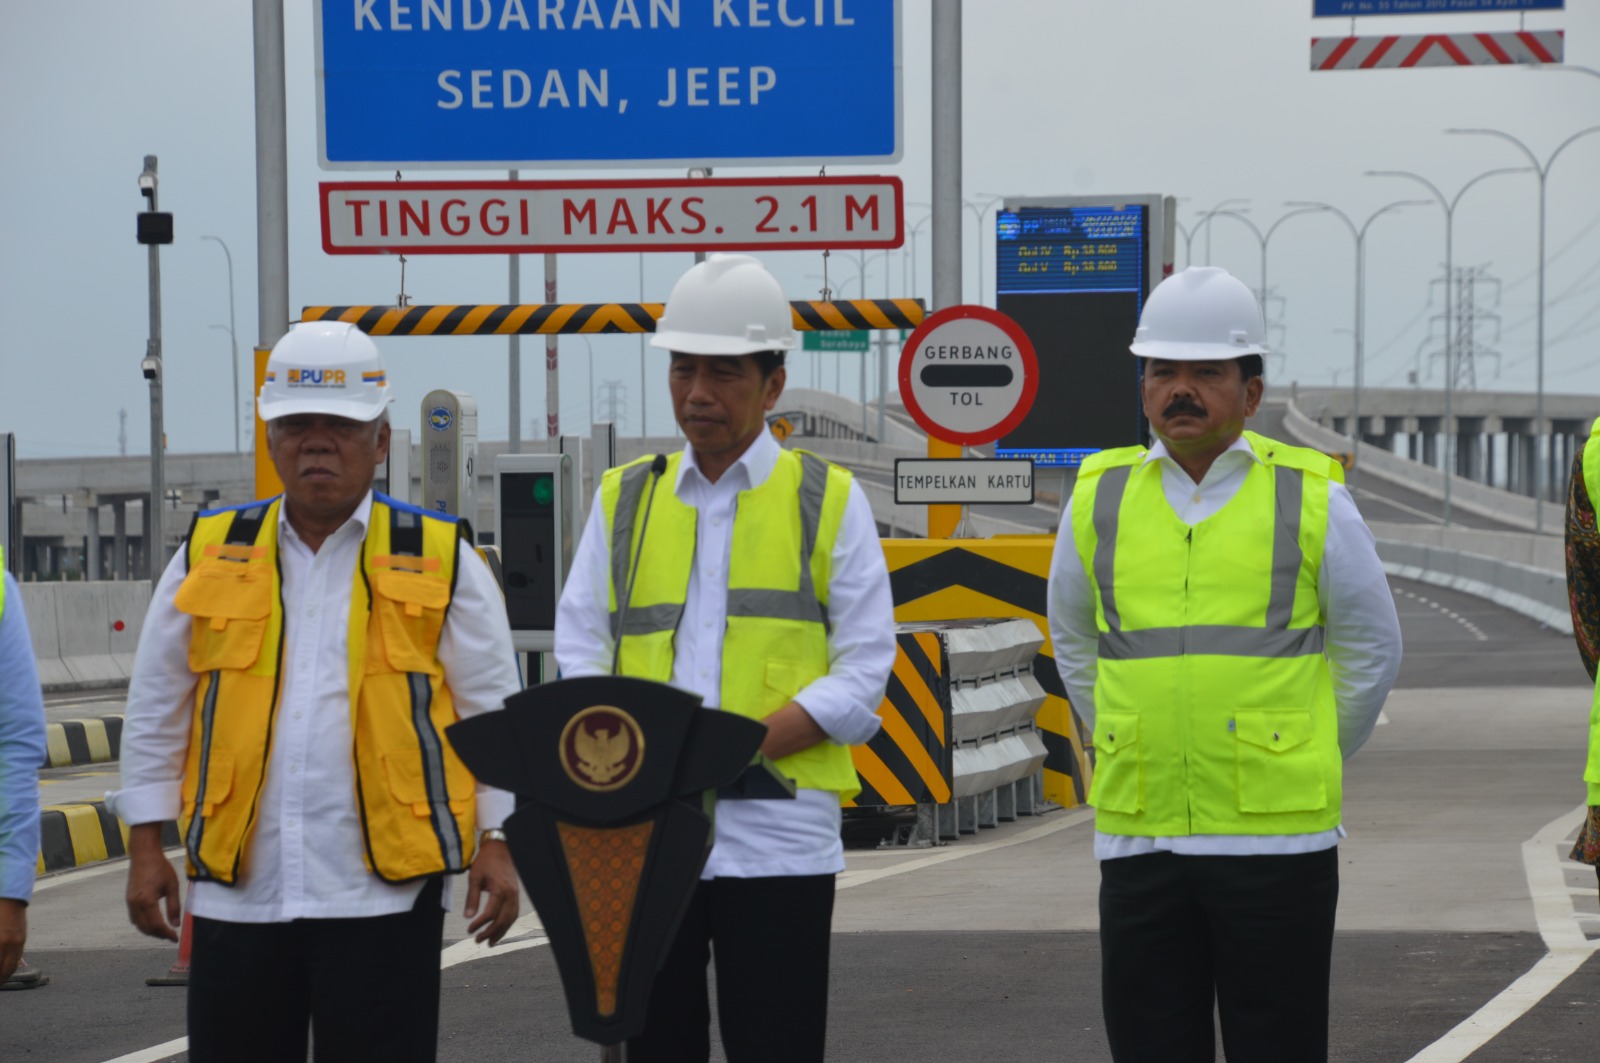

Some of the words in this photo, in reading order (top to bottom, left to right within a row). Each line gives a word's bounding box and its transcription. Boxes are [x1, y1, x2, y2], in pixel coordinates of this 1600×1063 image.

[354, 0, 680, 30] KENDARAAN
[713, 0, 855, 27] KECIL
[437, 69, 628, 114] SEDAN,
[658, 66, 777, 107] JEEP
[345, 199, 529, 237] TINGGI
[563, 197, 723, 235] MAKS.
[755, 195, 818, 233] 2.1
[845, 195, 880, 231] M
[925, 346, 1012, 360] GERBANG
[301, 370, 346, 384] PUPR
[950, 392, 983, 406] TOL
[899, 475, 976, 489] TEMPELKAN
[988, 475, 1031, 489] KARTU
